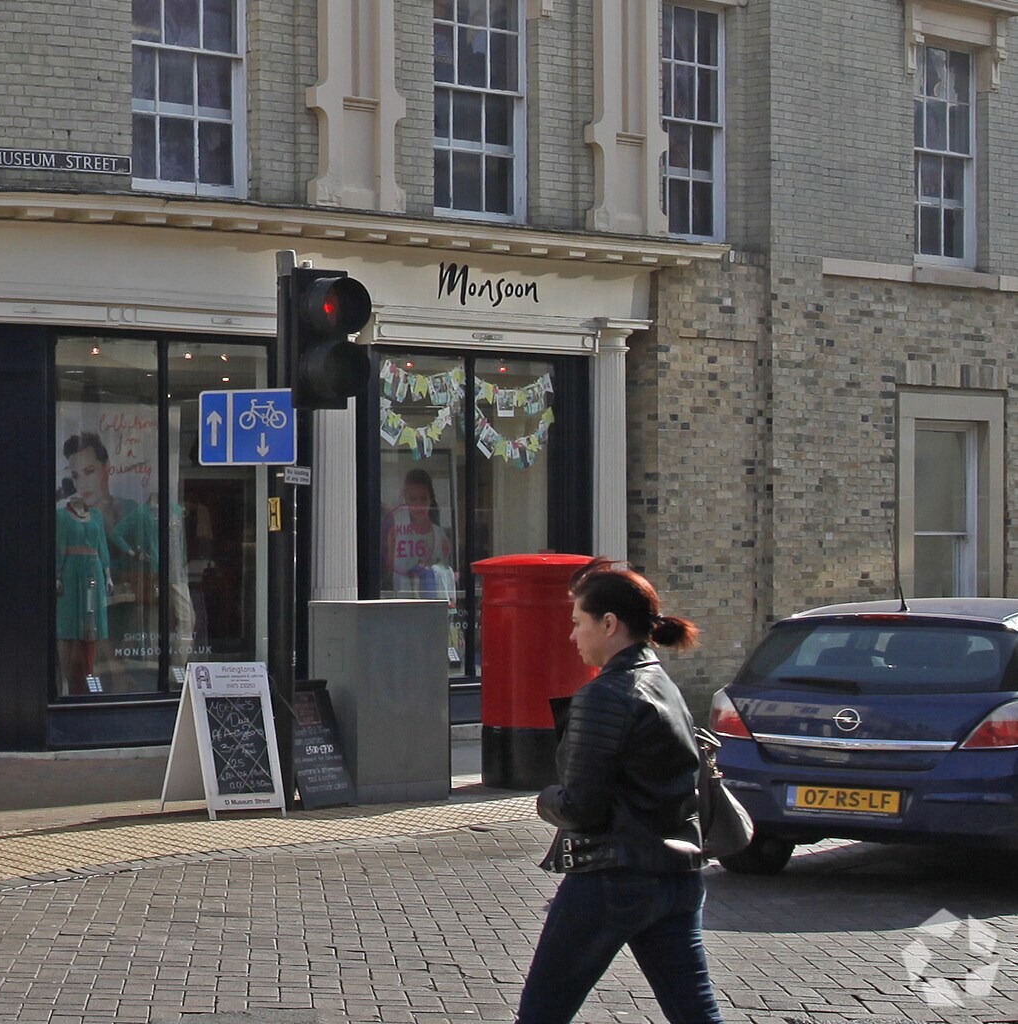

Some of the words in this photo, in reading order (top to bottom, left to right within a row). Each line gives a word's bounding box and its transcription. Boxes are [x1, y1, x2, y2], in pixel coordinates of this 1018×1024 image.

[66, 154, 118, 171] STREET
[438, 261, 539, 307] Monsoon
[397, 539, 426, 558] £16
[804, 789, 892, 809] 07-RS-LF
